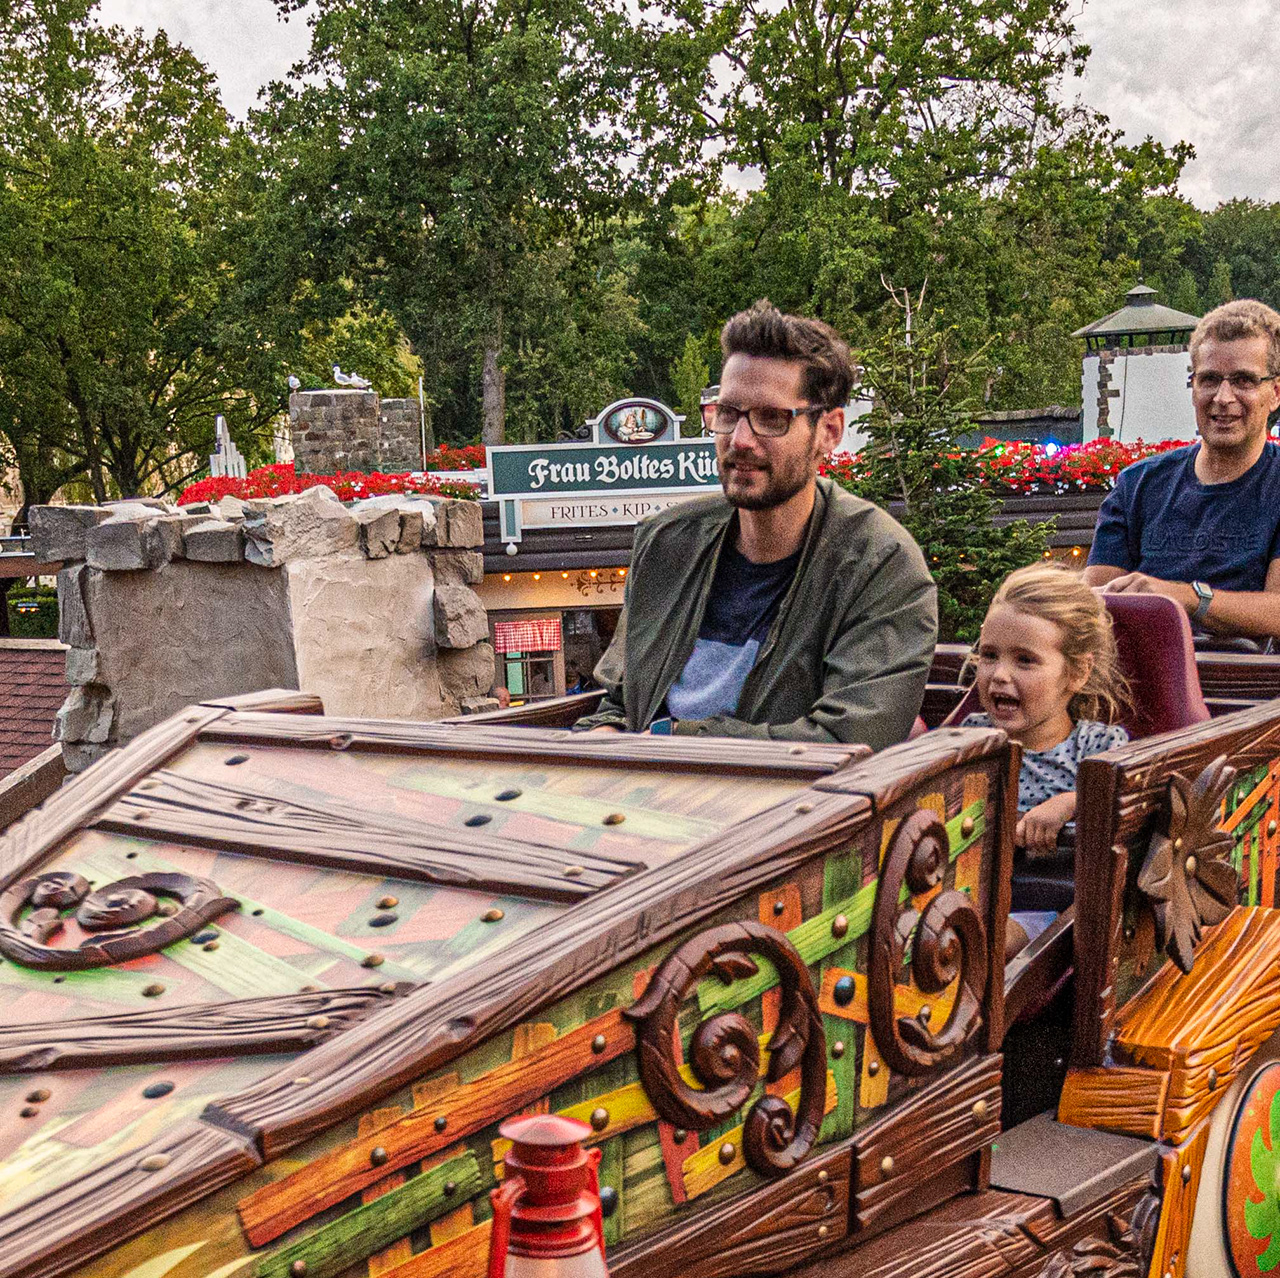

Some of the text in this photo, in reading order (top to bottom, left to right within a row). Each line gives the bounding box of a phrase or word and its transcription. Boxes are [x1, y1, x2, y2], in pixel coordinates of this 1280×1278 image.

[528, 458, 591, 489] Frau
[595, 454, 674, 484] Boltes
[551, 504, 609, 521] FRITES
[622, 502, 651, 518] KIP
[1147, 532, 1260, 552] LACOSTE
